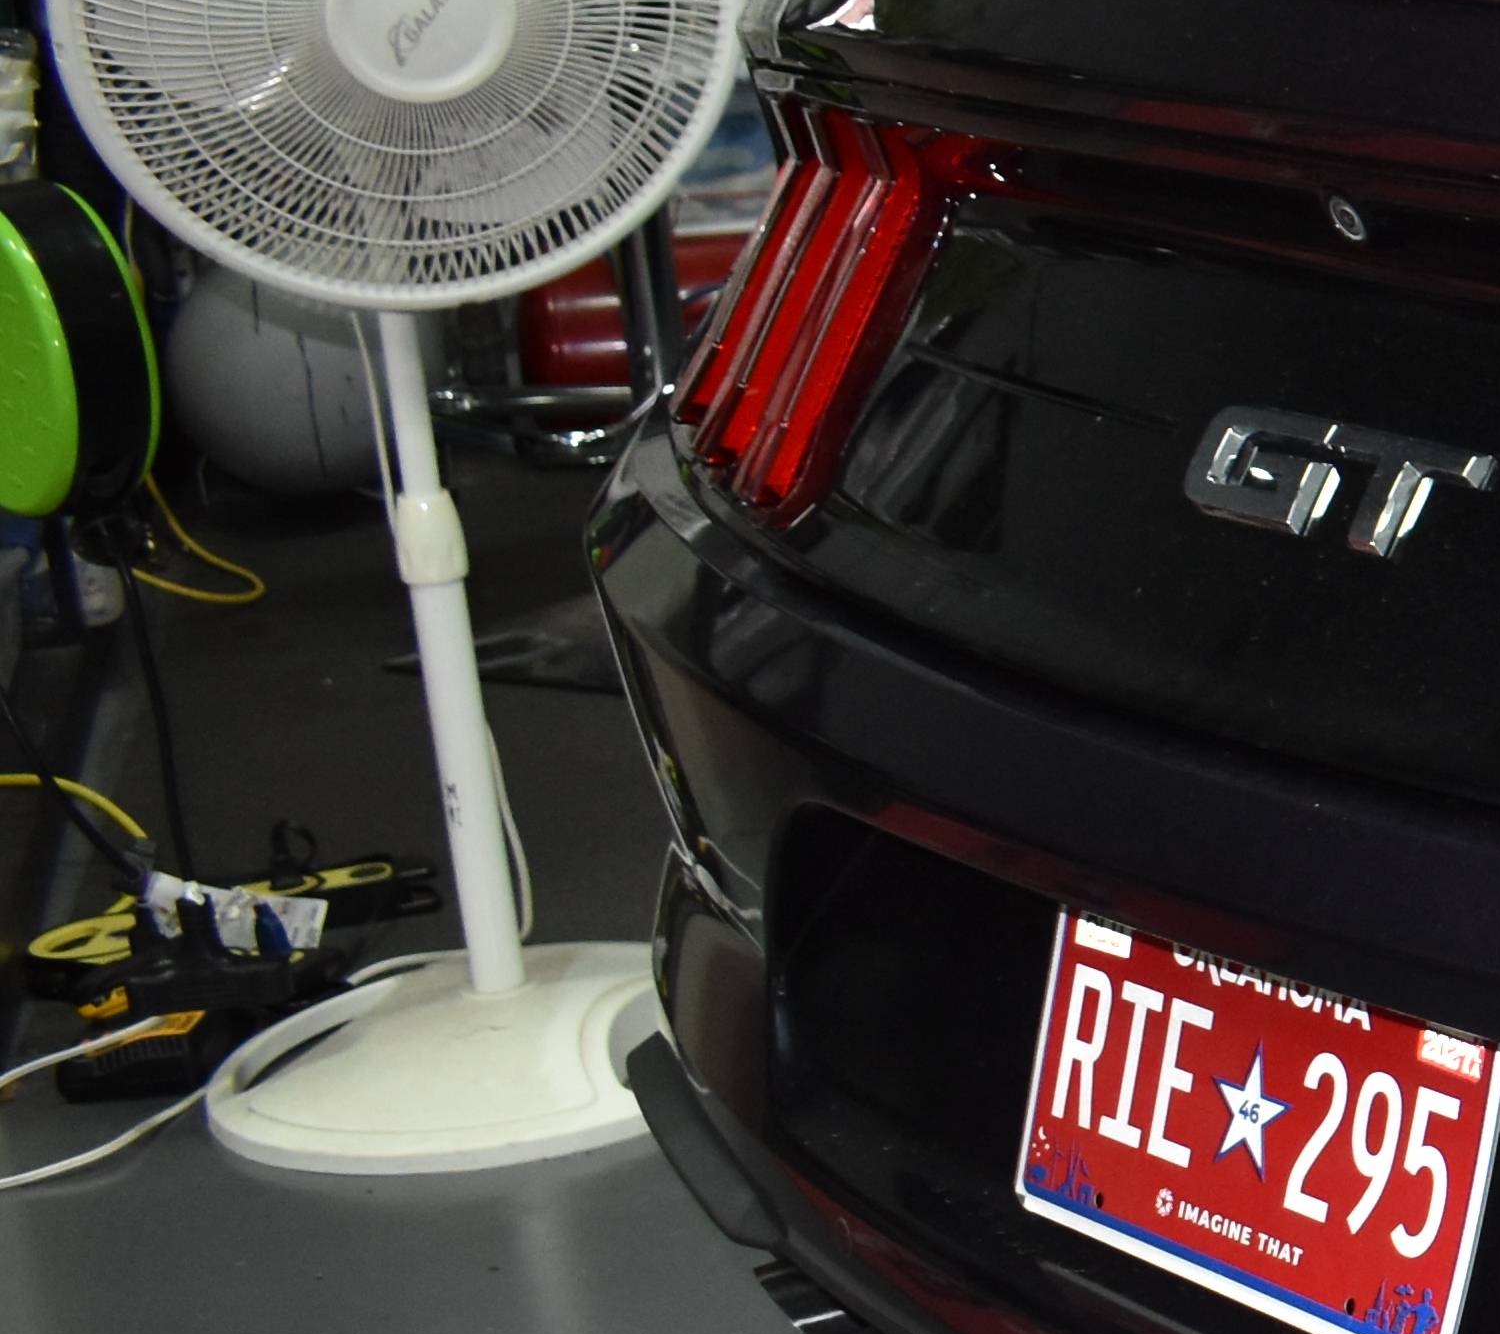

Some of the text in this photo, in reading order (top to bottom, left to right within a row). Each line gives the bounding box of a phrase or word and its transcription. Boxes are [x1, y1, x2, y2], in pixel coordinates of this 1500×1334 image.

[1184, 405, 1499, 560] GT
[1050, 962, 1462, 1260] RIE 295
[1238, 1098, 1261, 1125] 46
[1177, 1200, 1304, 1267] IMAGINE THAT
